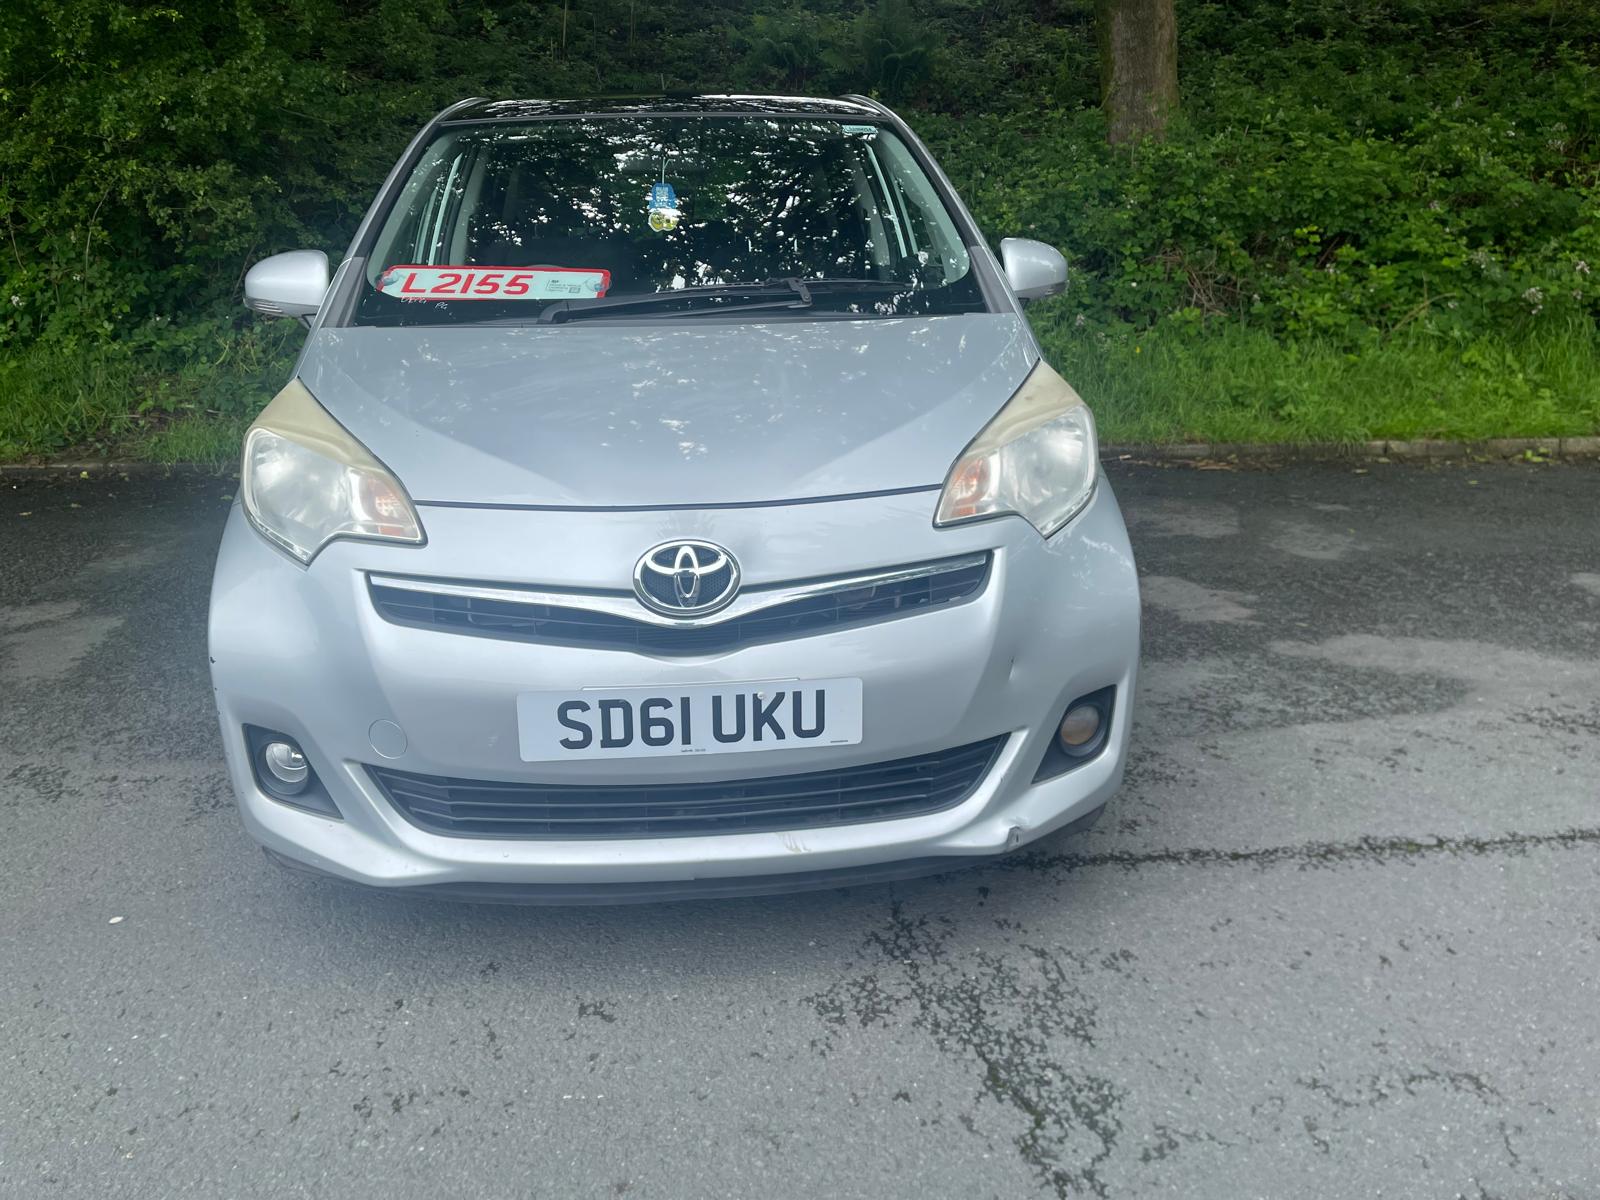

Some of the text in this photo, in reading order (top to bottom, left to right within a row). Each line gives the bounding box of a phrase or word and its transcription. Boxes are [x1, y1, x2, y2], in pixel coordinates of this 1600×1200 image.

[401, 273, 534, 295] L2155
[557, 689, 826, 750] SD61 UKU
